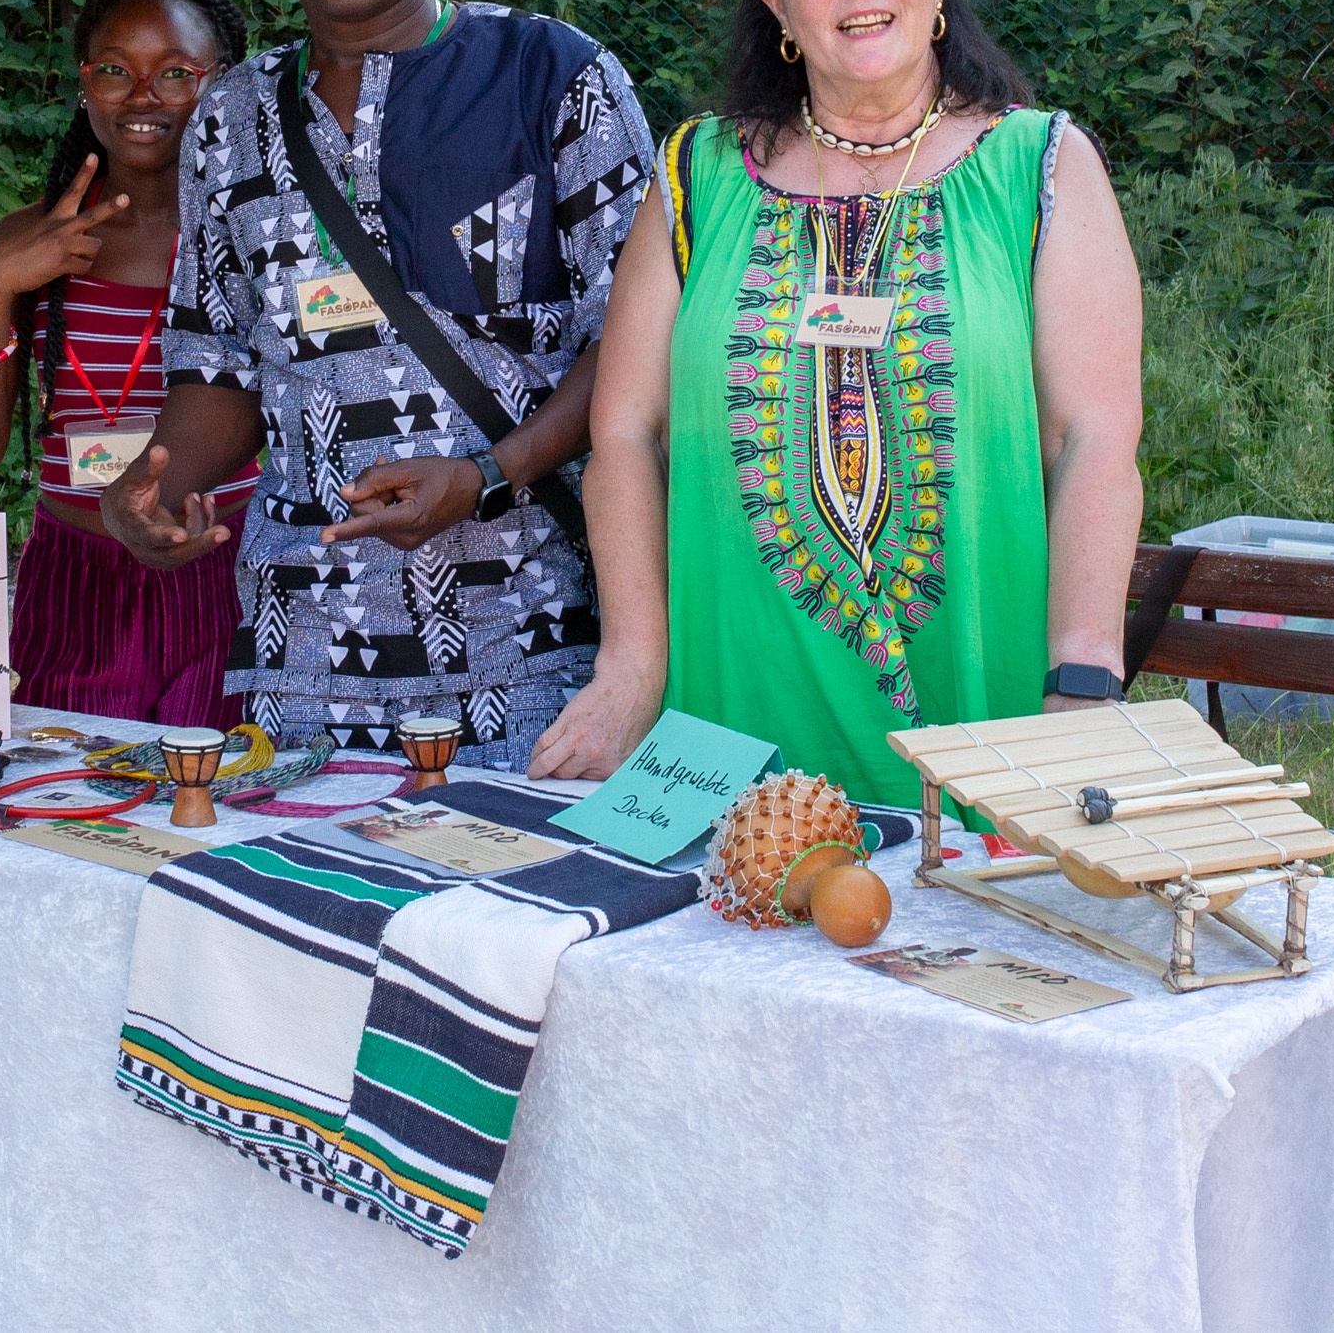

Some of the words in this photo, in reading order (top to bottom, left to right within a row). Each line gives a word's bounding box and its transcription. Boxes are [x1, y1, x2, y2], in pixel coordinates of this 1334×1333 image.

[818, 321, 882, 335] FASOPANI
[630, 741, 731, 797] Handgewebte
[611, 794, 671, 830] Decken
[52, 825, 182, 860] FASOPAN
